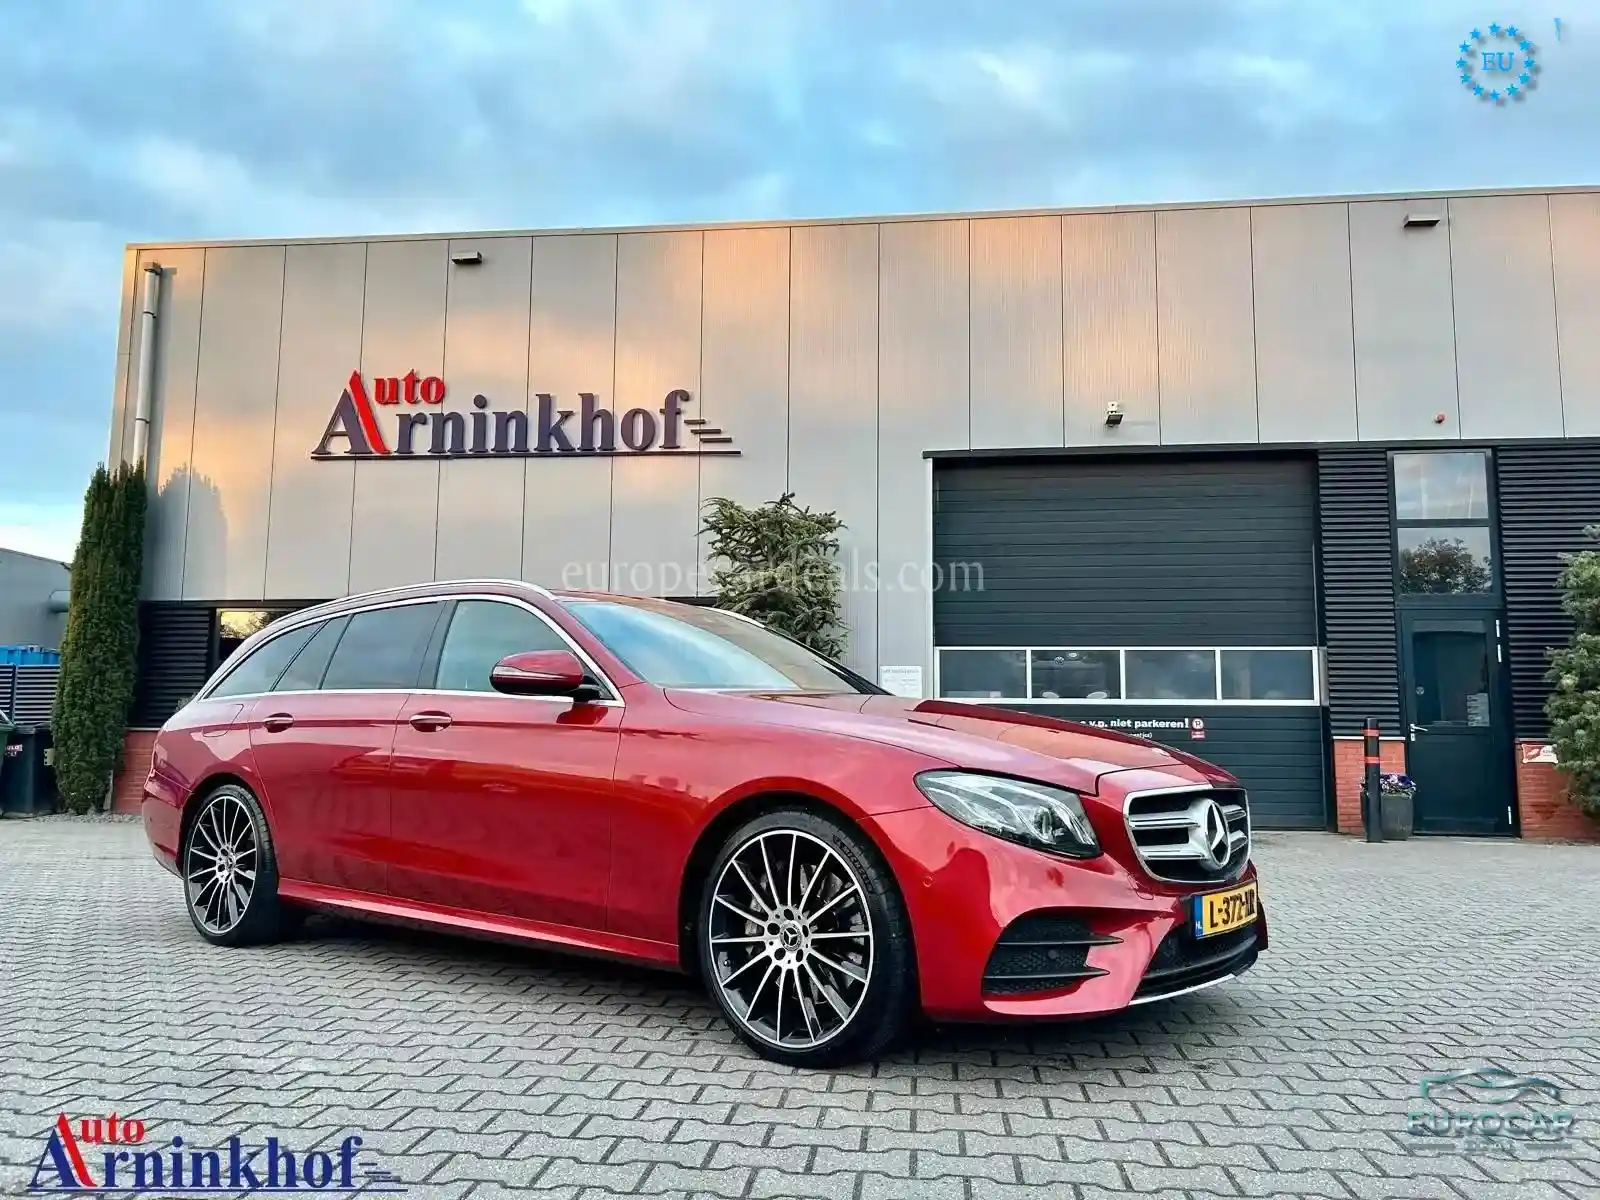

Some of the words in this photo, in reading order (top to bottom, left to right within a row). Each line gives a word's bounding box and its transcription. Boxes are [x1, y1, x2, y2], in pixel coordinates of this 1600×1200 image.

[311, 388, 690, 456] Arninkhof
[1110, 718, 1132, 728] niet
[1134, 718, 1189, 729] parkeren!
